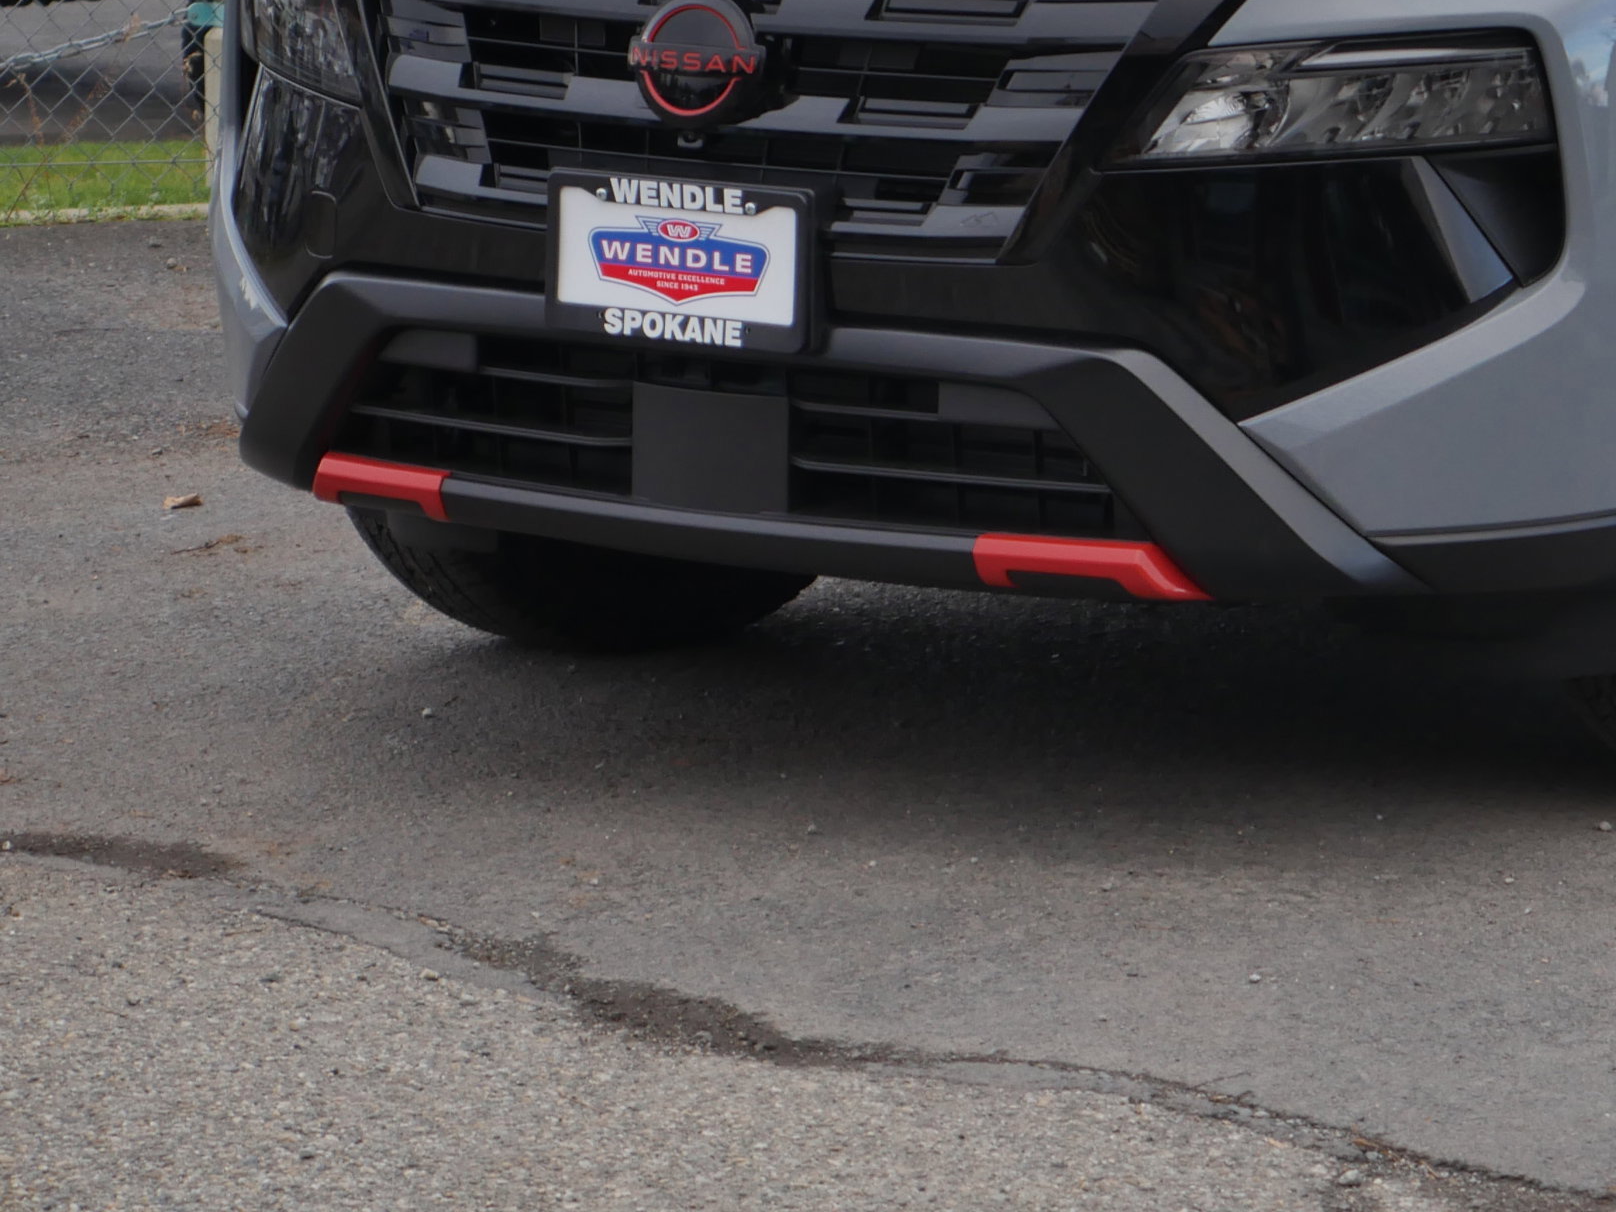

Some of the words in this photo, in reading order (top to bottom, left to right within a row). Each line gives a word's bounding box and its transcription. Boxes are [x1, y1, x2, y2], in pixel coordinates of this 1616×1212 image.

[631, 46, 756, 74] NISSAN
[609, 177, 744, 214] WENDLE
[602, 240, 752, 274] WENDLE
[628, 268, 676, 280] AUTOMOTIVE
[677, 274, 725, 286] EXCELLENCE
[656, 280, 679, 290] SINCE
[680, 283, 699, 292] 1943
[603, 308, 743, 348] SPOKANE
